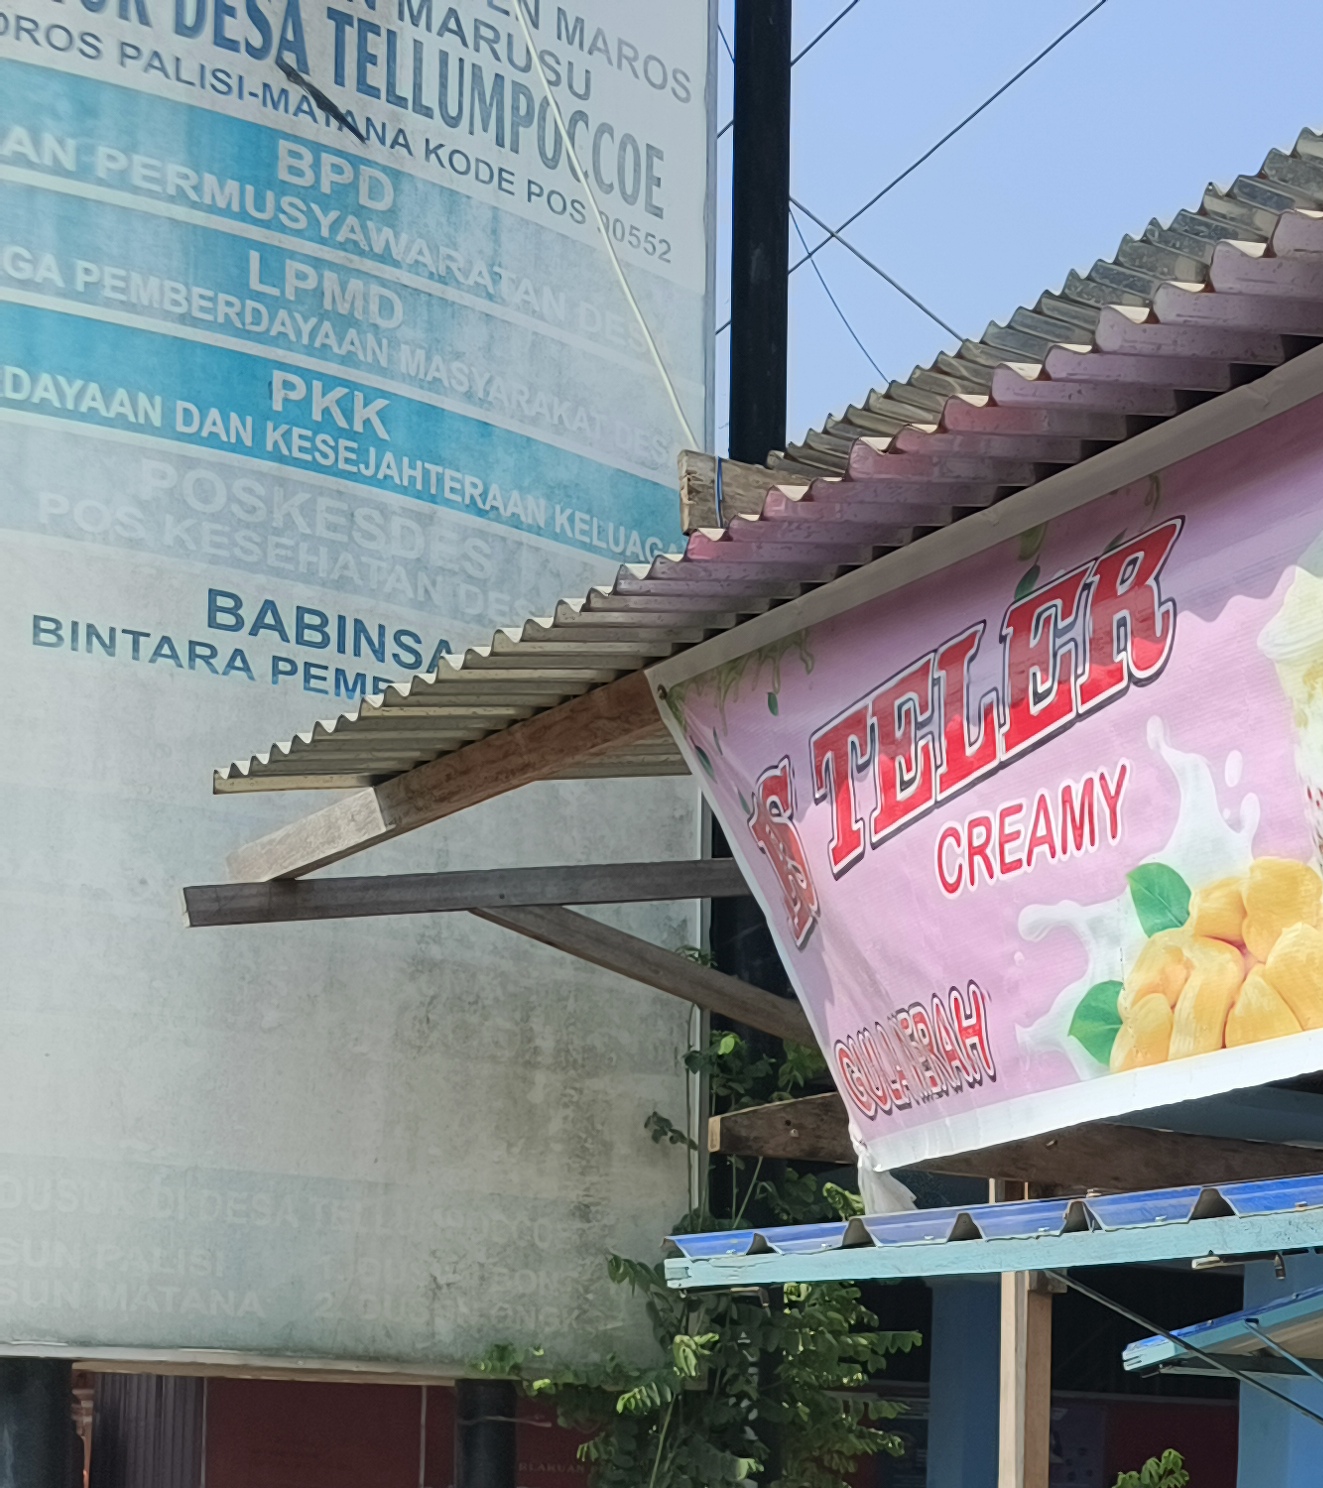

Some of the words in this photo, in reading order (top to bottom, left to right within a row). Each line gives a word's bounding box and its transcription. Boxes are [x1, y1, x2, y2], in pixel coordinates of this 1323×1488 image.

[556, 6, 692, 104] MAROS
[277, 138, 396, 213] BPD
[424, 138, 516, 196] KODE
[527, 178, 587, 225] POS
[76, 259, 390, 368] PEMBERDAYAAN
[249, 249, 404, 330] LPMD
[270, 369, 391, 441] PKK
[175, 401, 254, 447] DAN
[266, 423, 547, 530] KESEJAHTERAAN
[32, 614, 257, 683] BINTARA
[808, 513, 1187, 882] TELER
[934, 756, 1133, 898] CREAMY
